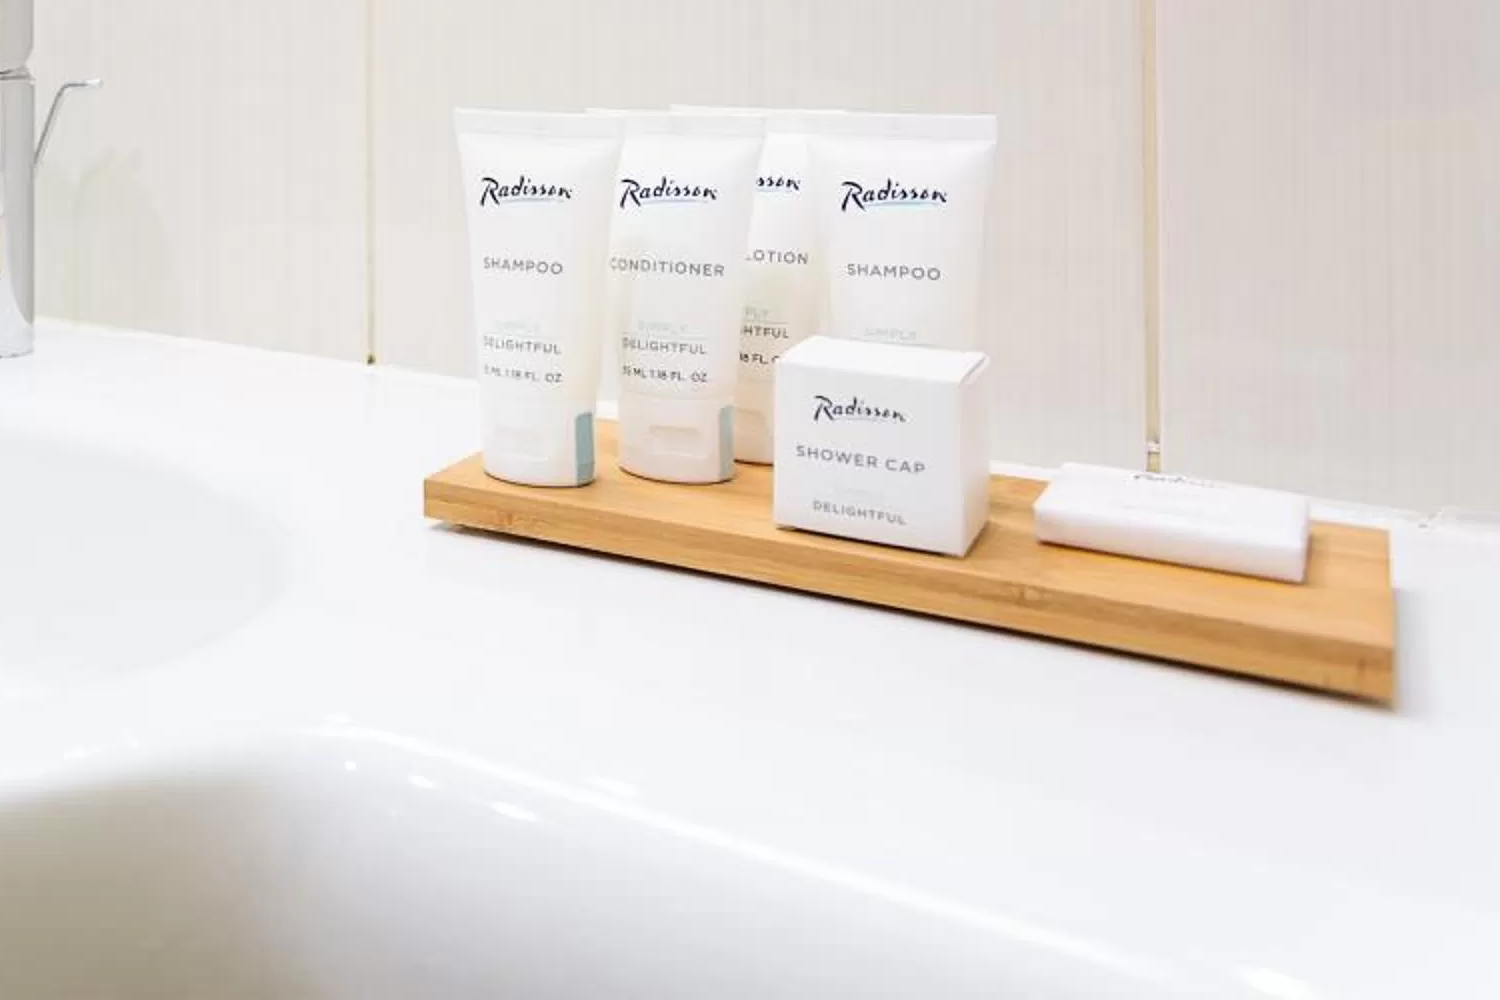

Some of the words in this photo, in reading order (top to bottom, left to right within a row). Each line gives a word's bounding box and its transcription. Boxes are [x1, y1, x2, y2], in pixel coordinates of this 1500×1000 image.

[480, 175, 573, 207] Radisson
[620, 176, 717, 208] Radisson
[756, 176, 801, 191] sson
[841, 178, 948, 212] Radisson
[483, 256, 564, 275] SHAMPOO
[611, 257, 726, 277] CONDITIONER
[847, 263, 941, 281] SHAMPOO
[740, 324, 789, 340] HTFUL
[621, 337, 708, 355] DELIGHTFUL
[813, 395, 907, 423] Radisson
[796, 445, 879, 469] SHOWER
[885, 459, 926, 474] CAP
[812, 500, 908, 526] DELIGHTFUL
